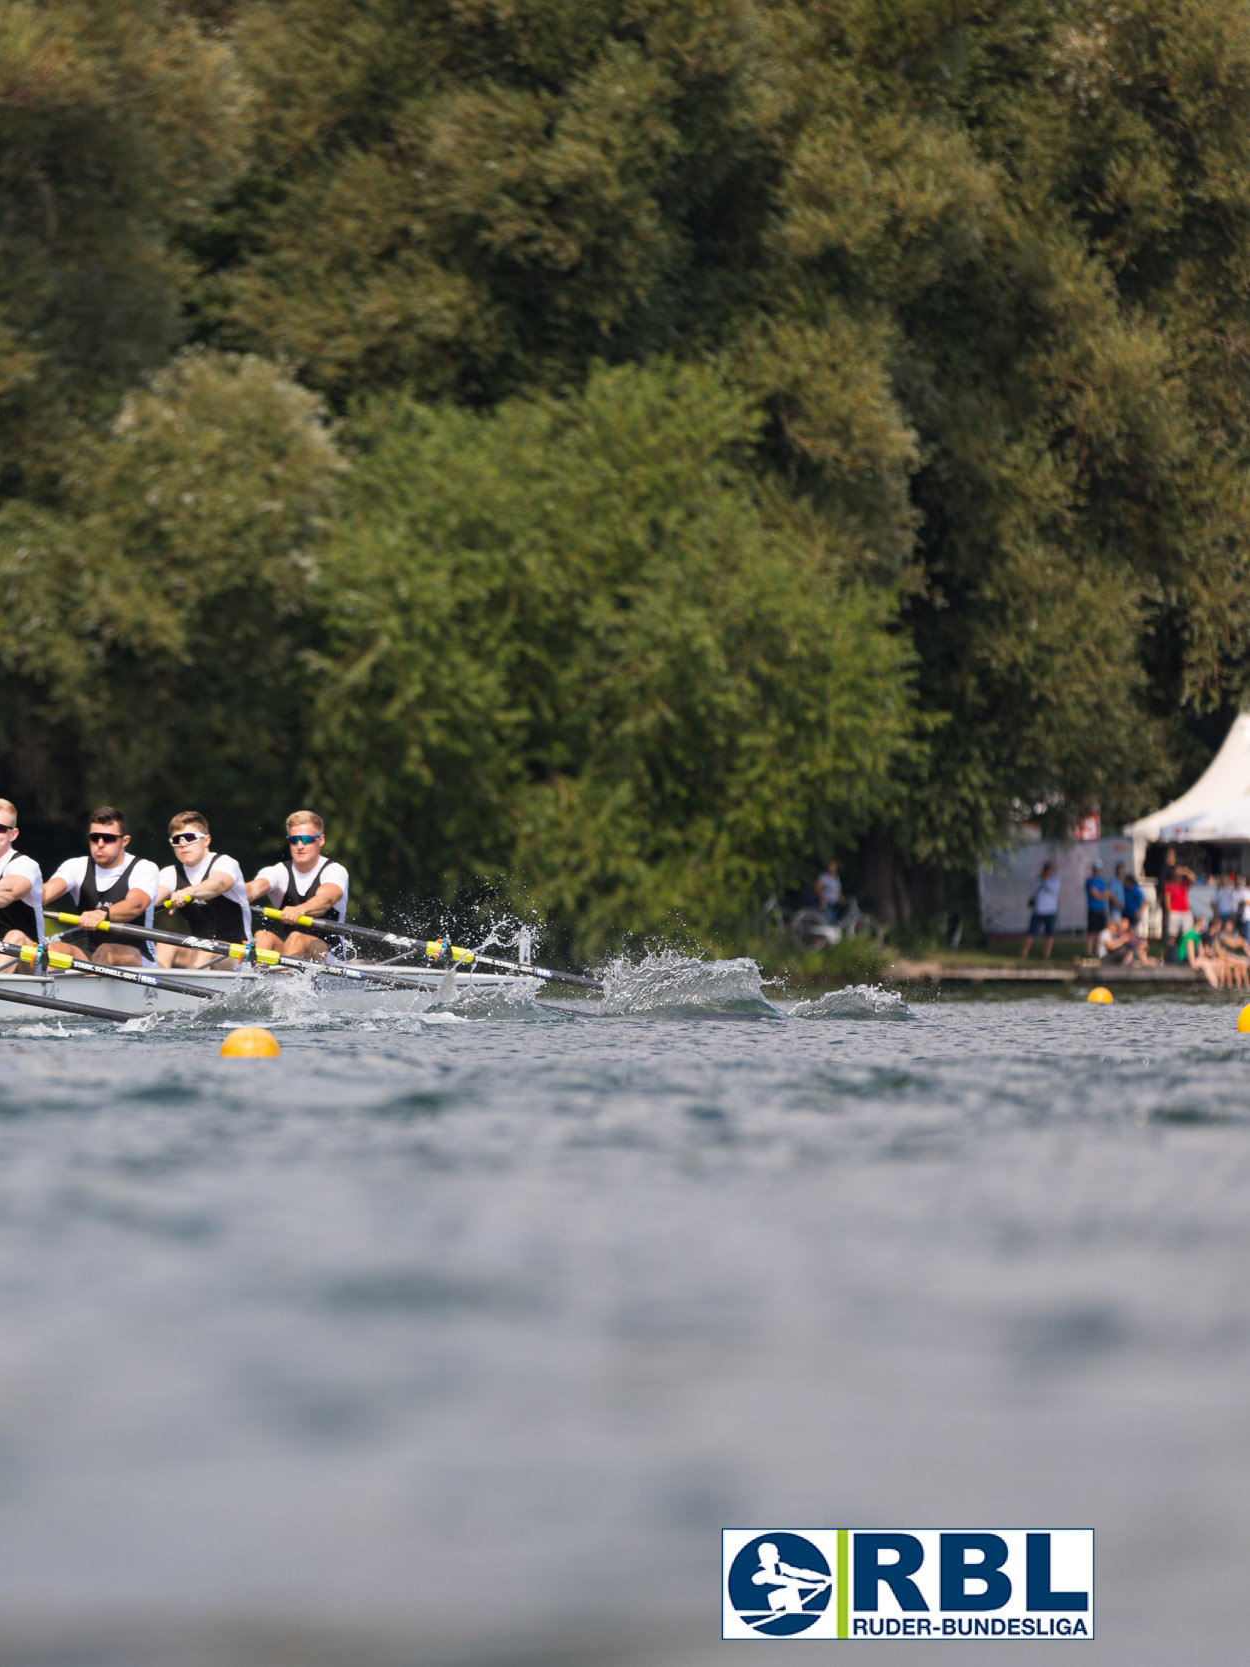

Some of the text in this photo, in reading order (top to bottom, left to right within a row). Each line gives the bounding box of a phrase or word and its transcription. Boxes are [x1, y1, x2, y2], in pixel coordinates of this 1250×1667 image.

[73, 961, 95, 972] STARK.
[122, 972, 138, 981] GUT.
[140, 974, 157, 984] RBL
